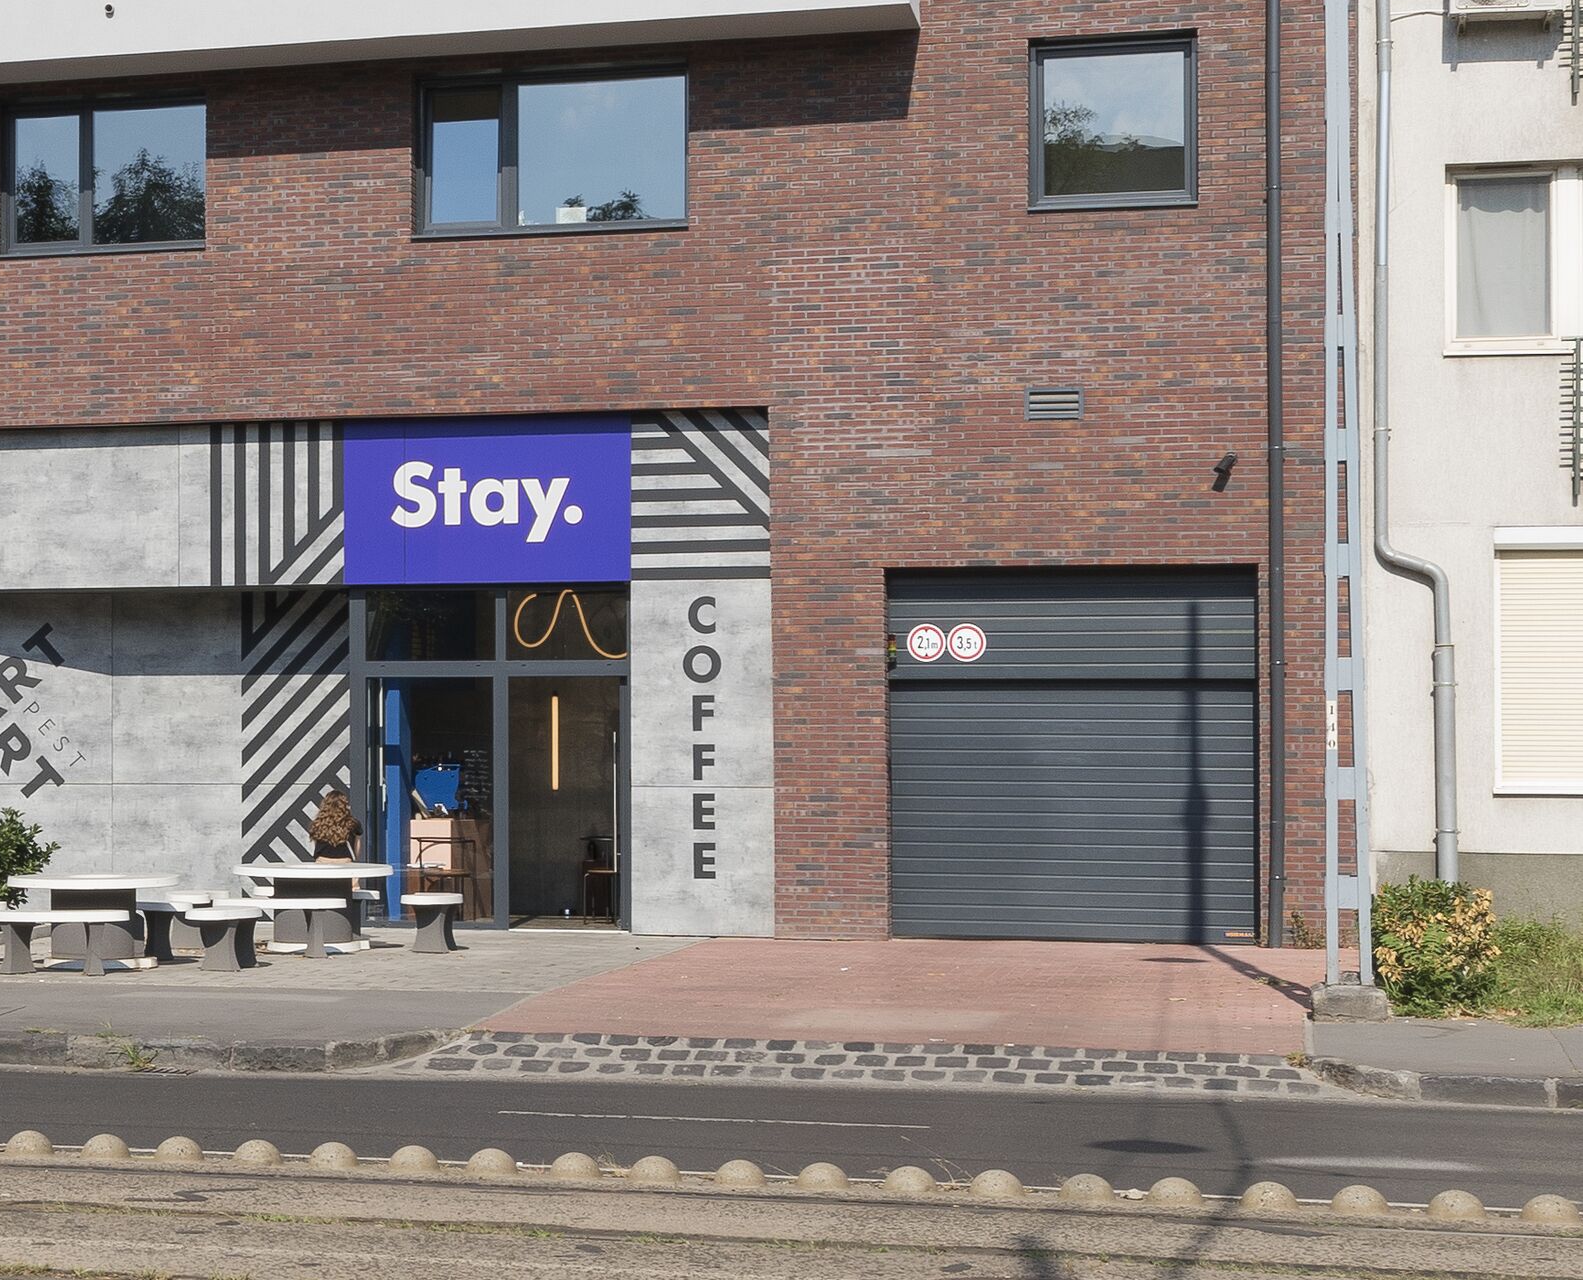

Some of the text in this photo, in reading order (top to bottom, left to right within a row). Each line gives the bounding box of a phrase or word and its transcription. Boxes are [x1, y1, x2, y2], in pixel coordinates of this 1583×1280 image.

[390, 460, 583, 544] Stay.
[22, 700, 87, 768] PEST
[683, 595, 722, 880] COFFEE
